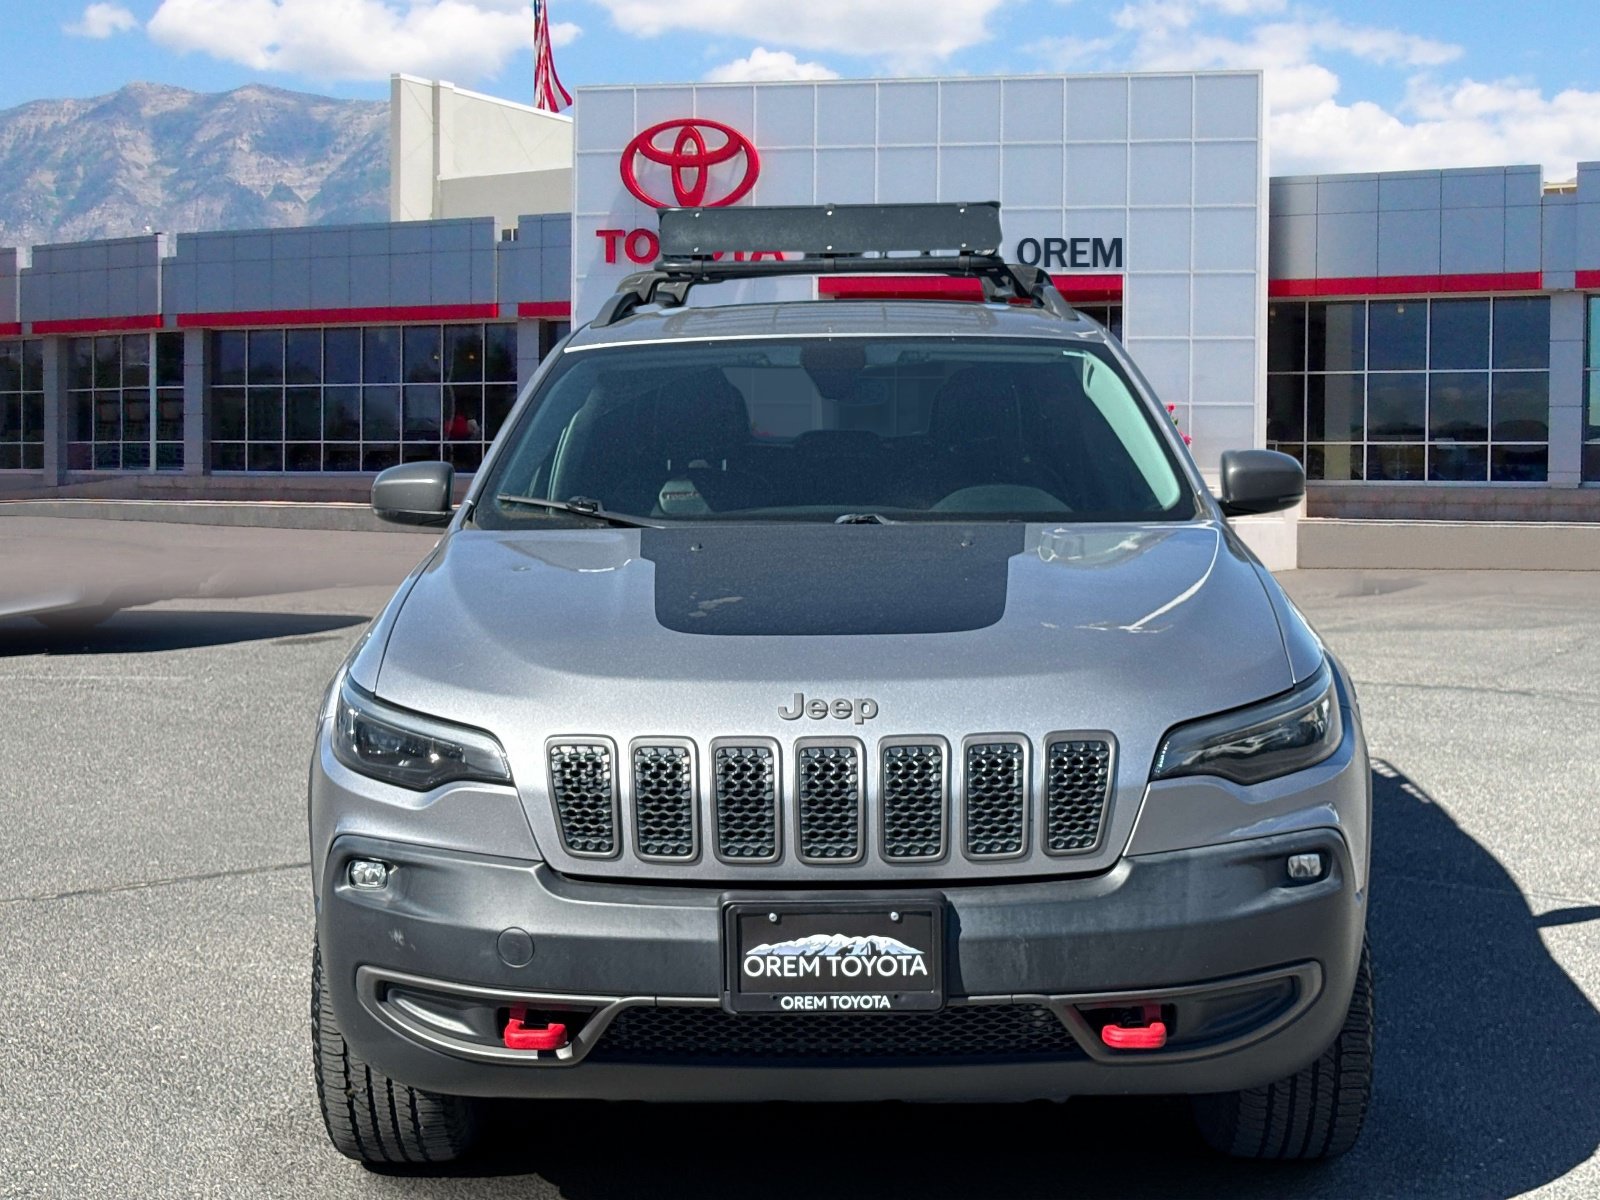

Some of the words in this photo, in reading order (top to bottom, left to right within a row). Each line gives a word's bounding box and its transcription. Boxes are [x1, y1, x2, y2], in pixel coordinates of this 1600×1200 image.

[1018, 237, 1122, 267] OREM
[778, 693, 879, 725] Jeep
[743, 956, 820, 977] OREM
[826, 955, 928, 977] TOYOTA
[781, 996, 827, 1010] OREM
[830, 995, 891, 1009] TOYOTA
